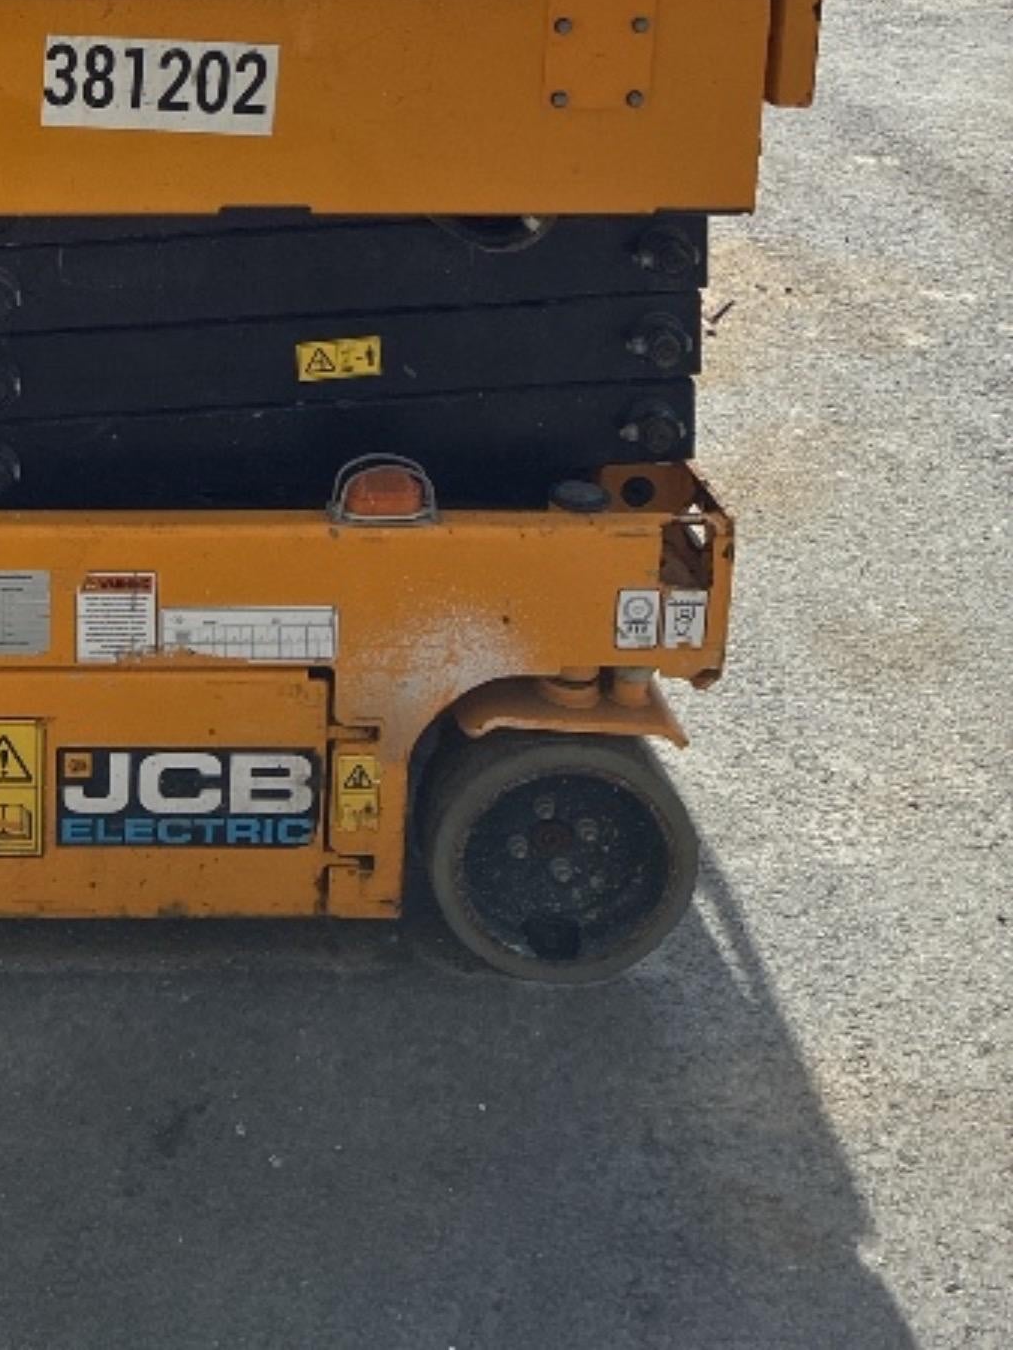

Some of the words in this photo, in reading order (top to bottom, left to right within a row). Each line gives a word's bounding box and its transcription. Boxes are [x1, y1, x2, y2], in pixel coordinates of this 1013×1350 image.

[43, 42, 268, 115] 381202
[62, 751, 313, 814] JCB
[61, 817, 313, 845] ELECTRIC
